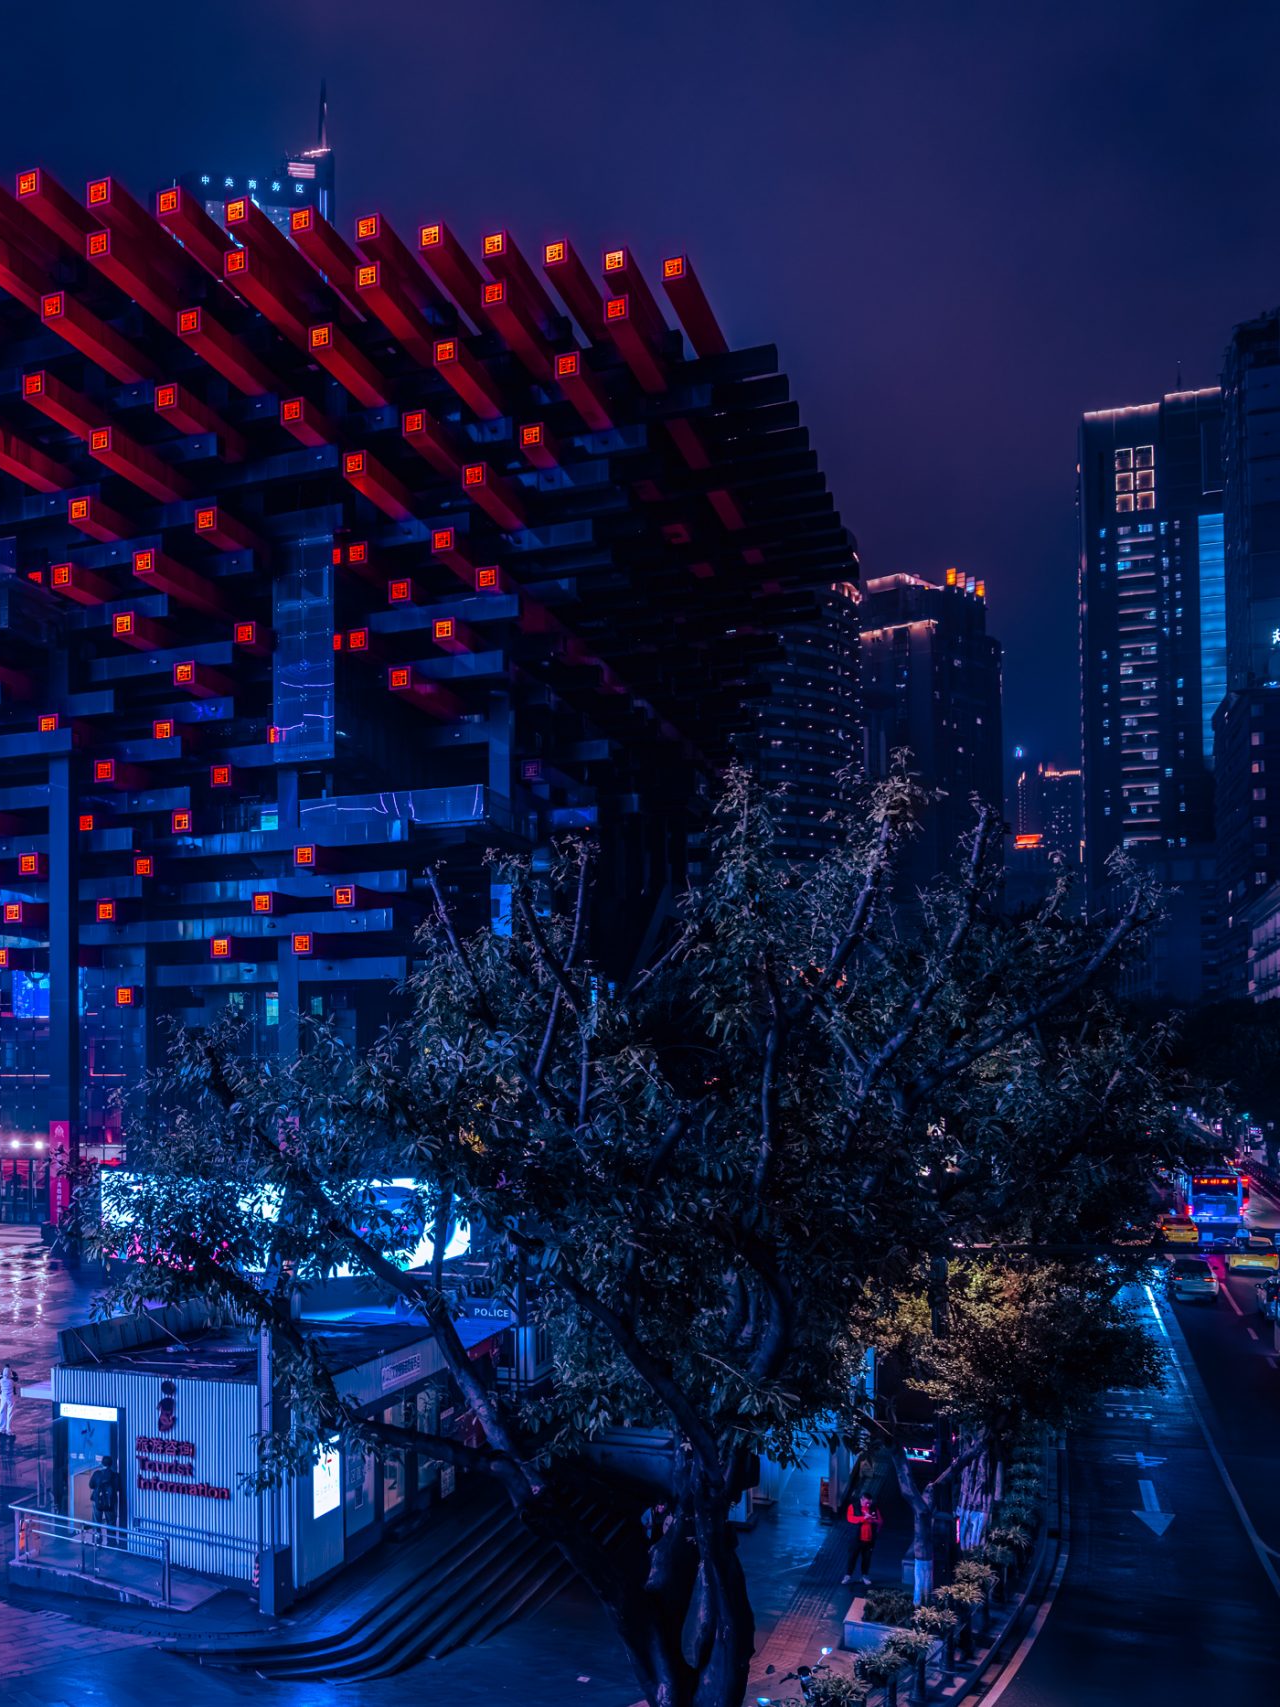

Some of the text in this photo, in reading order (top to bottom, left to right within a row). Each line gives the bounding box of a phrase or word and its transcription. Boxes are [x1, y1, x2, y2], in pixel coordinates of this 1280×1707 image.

[201, 175, 304, 193] 中央商务区
[474, 1307, 510, 1318] POLICE
[136, 1436, 195, 1457] 旅游咨询
[136, 1456, 193, 1477] Tourist
